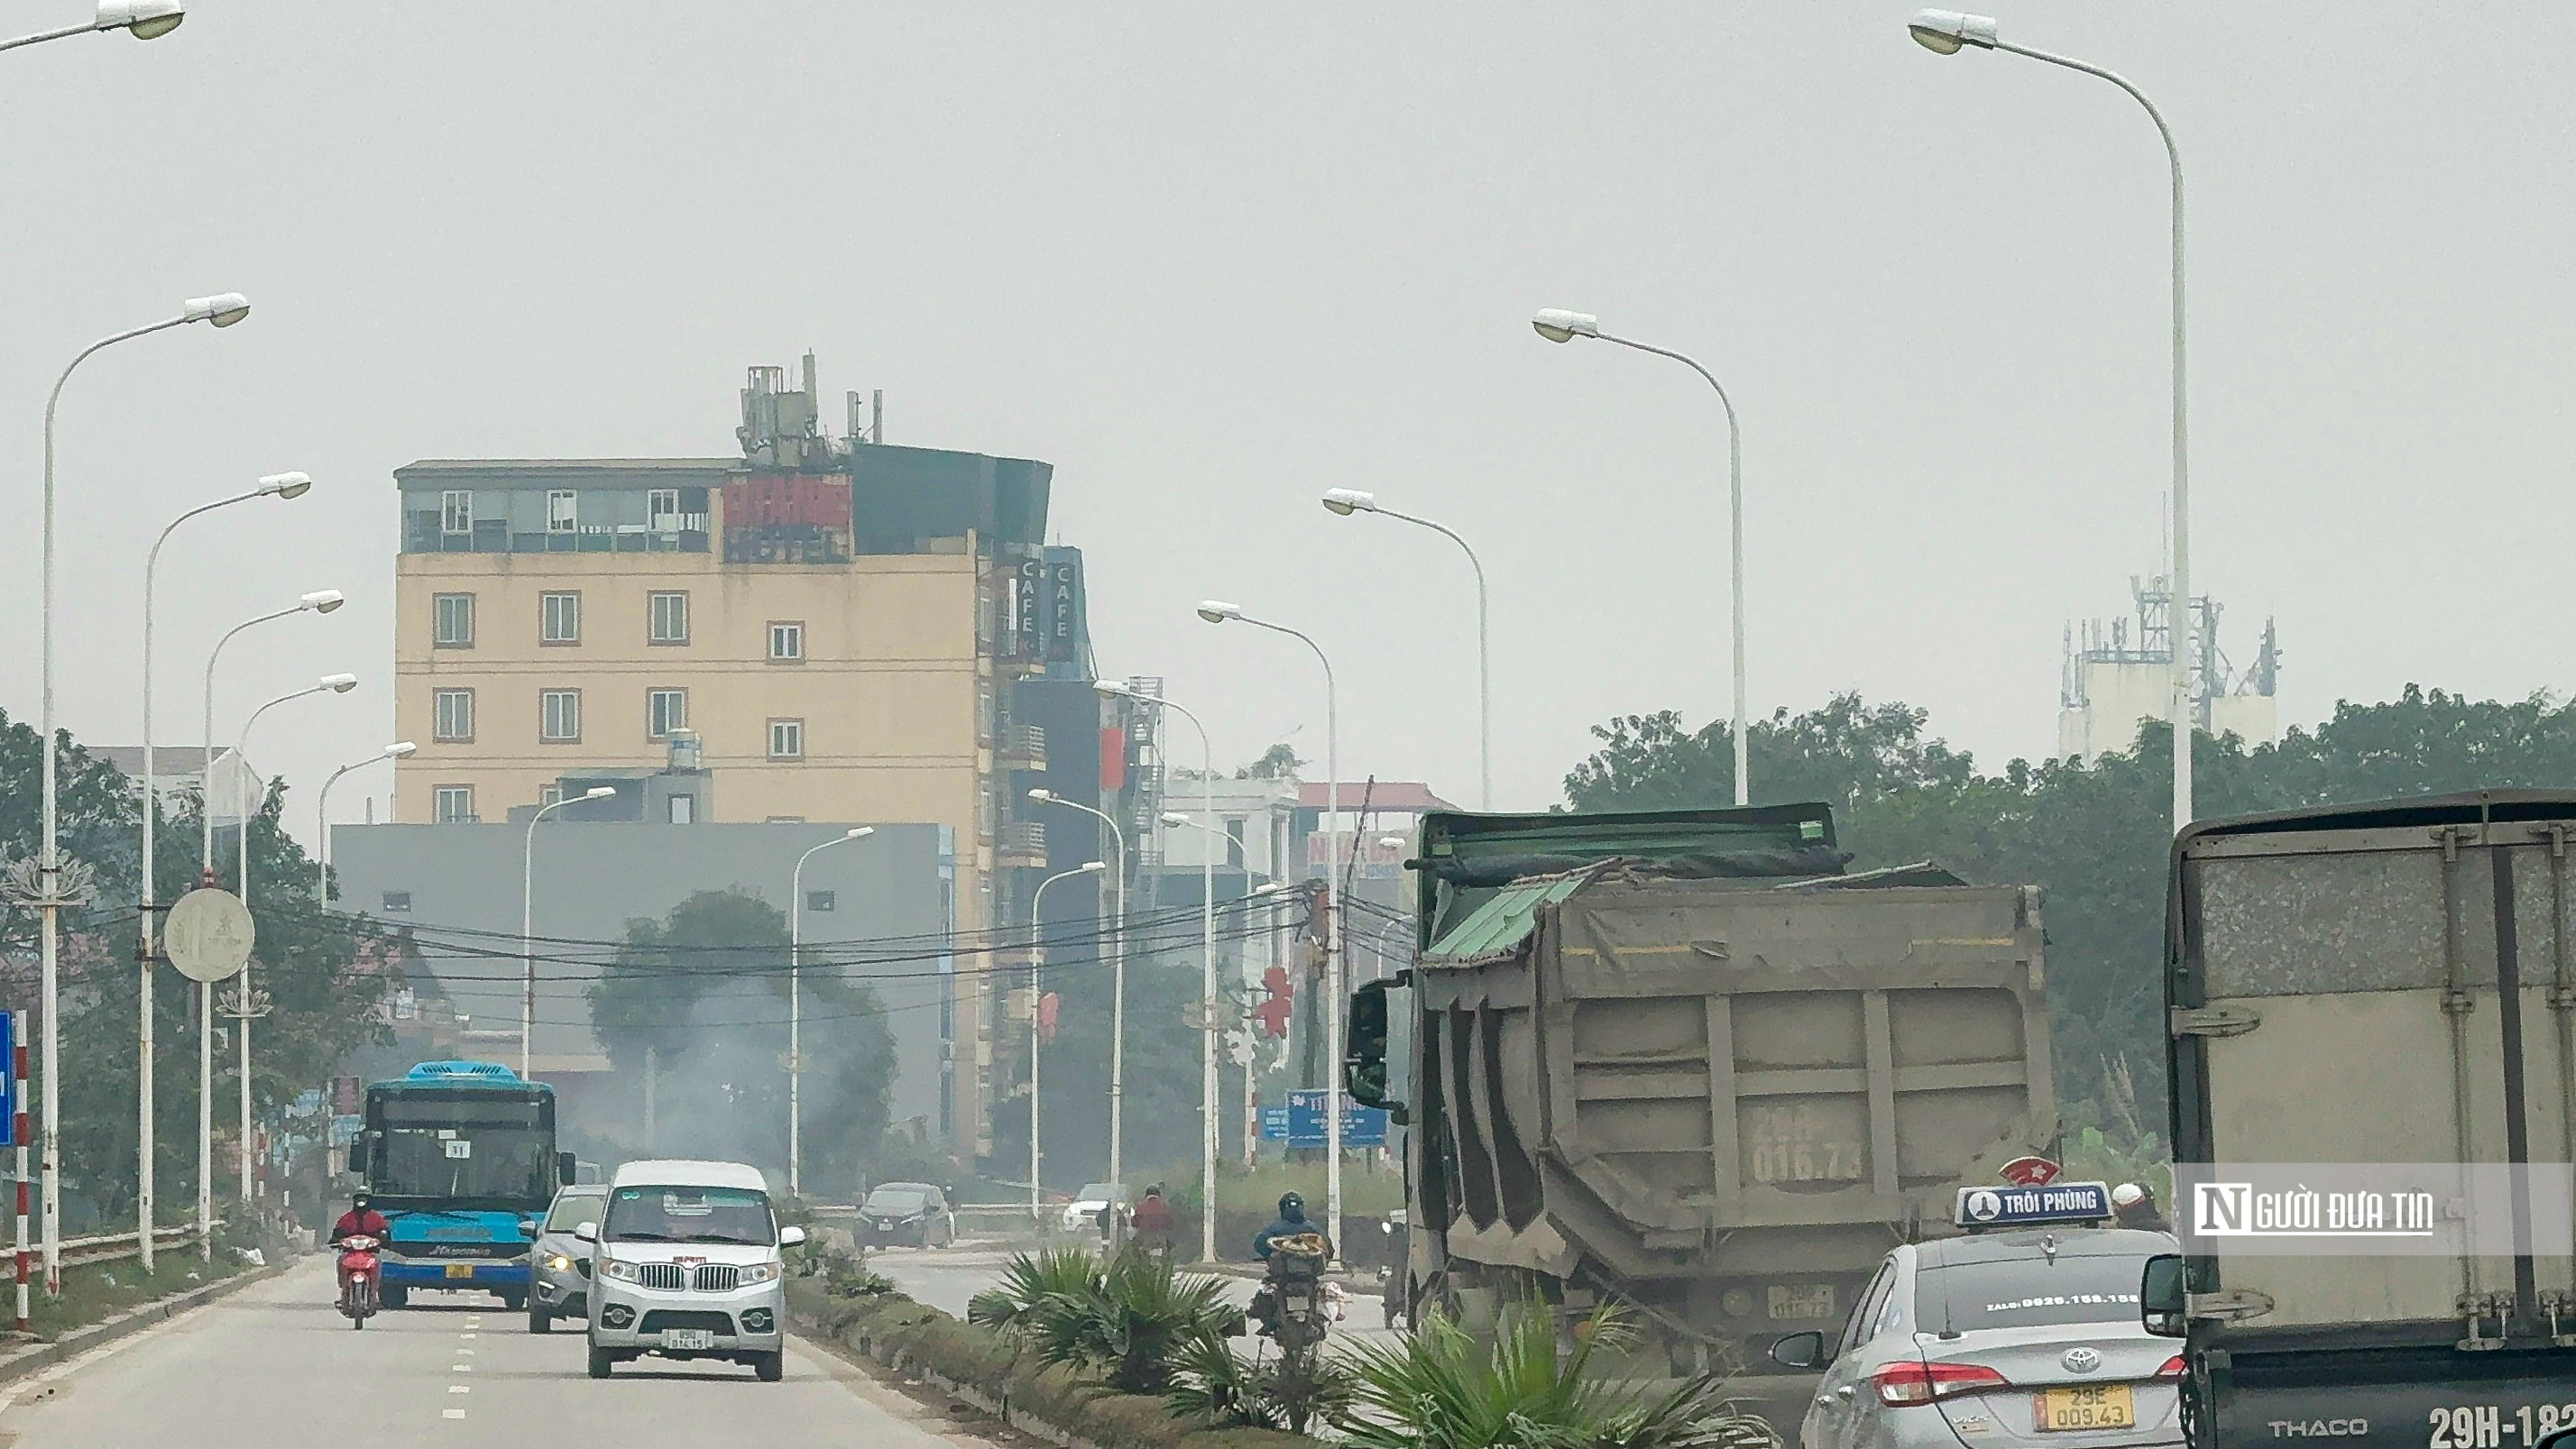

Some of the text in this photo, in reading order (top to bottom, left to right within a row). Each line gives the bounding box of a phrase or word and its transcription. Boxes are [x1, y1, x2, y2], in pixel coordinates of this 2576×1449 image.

[1022, 562, 1035, 632] CAFE
[1056, 567, 1069, 637] CAFE
[2004, 1190, 2040, 1214] TRÔI
[2057, 1406, 2124, 1426] 009.43
[2268, 1417, 2369, 1438] THACO
